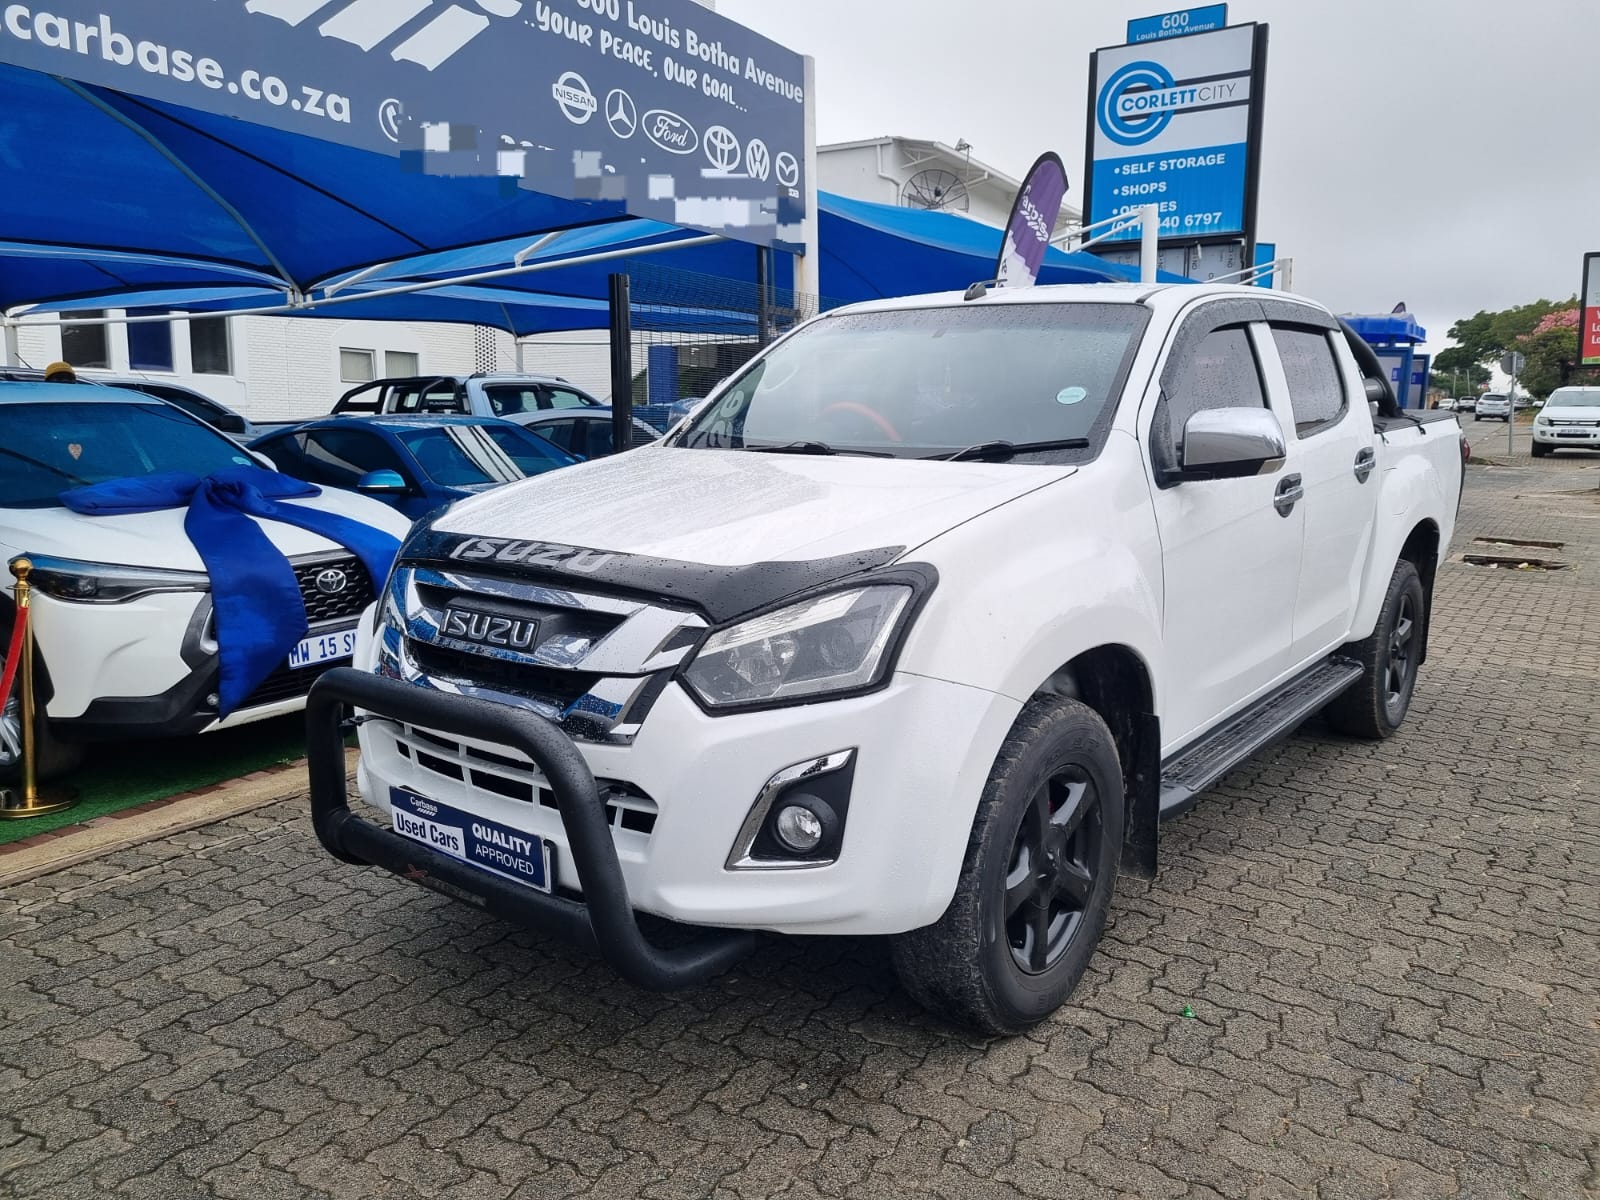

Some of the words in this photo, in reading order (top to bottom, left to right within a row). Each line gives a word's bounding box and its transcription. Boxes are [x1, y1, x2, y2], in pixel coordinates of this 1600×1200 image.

[1135, 31, 1157, 41] Louis
[1158, 27, 1183, 38] Botha
[1183, 22, 1215, 33] Avenue
[1161, 12, 1190, 29] 600
[0, 4, 351, 123] carbase.co.za
[627, 1, 680, 48] Louis
[686, 28, 740, 75] Botha
[744, 57, 804, 104] Avenue
[663, 56, 698, 89] OUR
[555, 87, 595, 108] NISSAN
[653, 115, 689, 147] Ford
[1122, 161, 1155, 175] SELF
[1159, 153, 1226, 172] STORAGE
[1121, 181, 1167, 196] SHOPS
[1158, 216, 1181, 229] 40
[1184, 212, 1222, 227] 6797
[450, 537, 613, 573] ISUZU
[440, 608, 535, 648] ISUZU
[319, 636, 337, 659] 15
[410, 796, 438, 813] Carbase
[396, 812, 427, 840] Used
[430, 824, 459, 851] Cars
[472, 823, 532, 857] QUALITY
[475, 844, 534, 875] APPROVED
